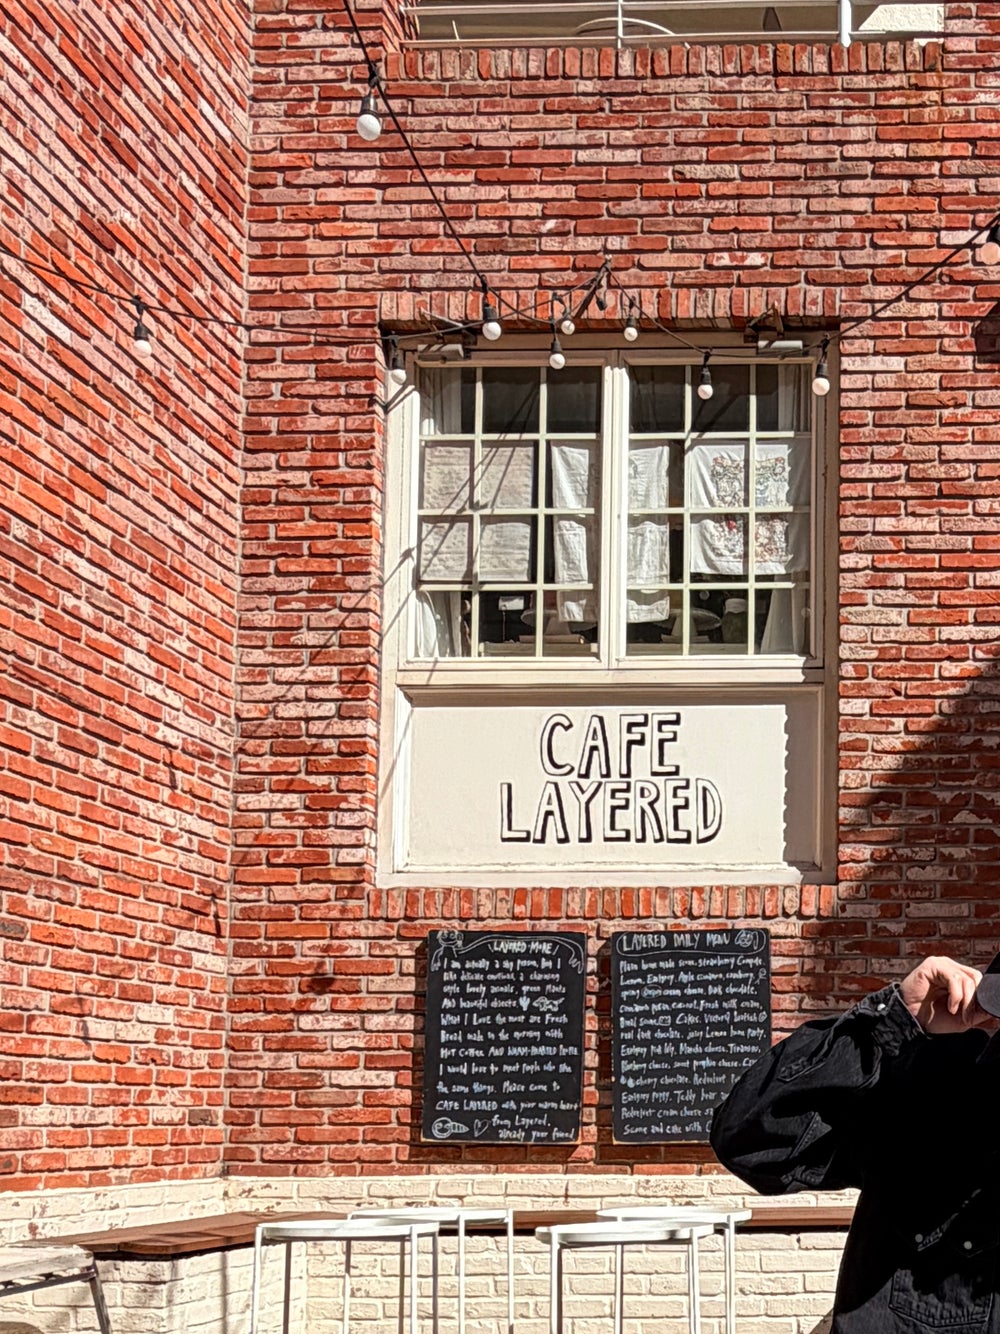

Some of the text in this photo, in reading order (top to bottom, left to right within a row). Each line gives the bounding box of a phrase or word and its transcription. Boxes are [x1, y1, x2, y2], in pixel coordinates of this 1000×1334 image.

[540, 712, 682, 779] CAFE
[500, 778, 723, 845] LAYERED
[622, 932, 731, 952] LAYERED DAILY MENU
